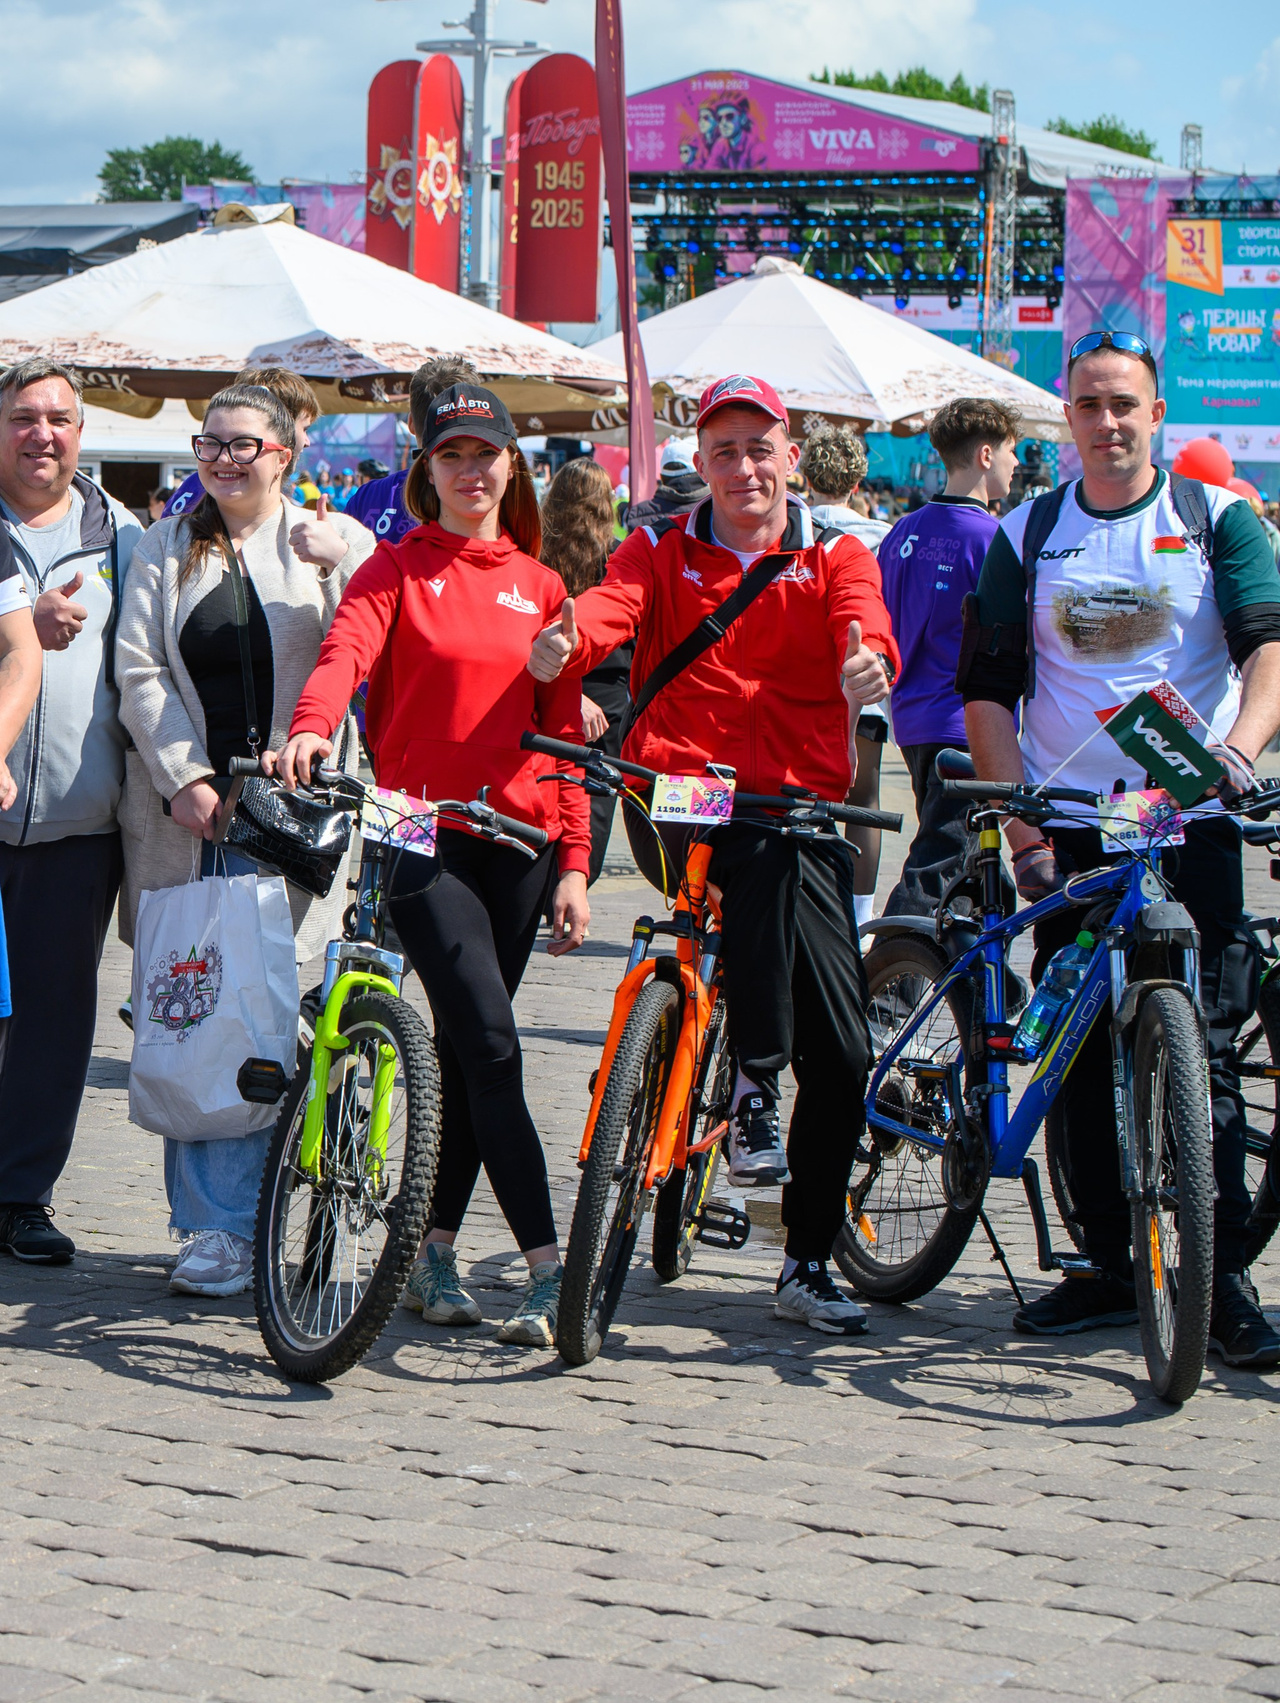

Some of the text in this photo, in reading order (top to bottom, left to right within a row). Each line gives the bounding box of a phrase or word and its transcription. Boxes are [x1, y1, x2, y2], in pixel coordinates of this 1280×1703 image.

[808, 128, 875, 150] VIVA
[534, 161, 585, 191] 1945
[530, 198, 584, 228] 2025
[1181, 227, 1206, 253] 31
[1203, 308, 1267, 327] ПЕРШЫ
[1208, 333, 1261, 353] РОВАР
[1177, 376, 1205, 389] Тема
[1132, 714, 1202, 777] VOLAT
[656, 805, 687, 813] 11905
[1042, 979, 1108, 1096] AUTHOR
